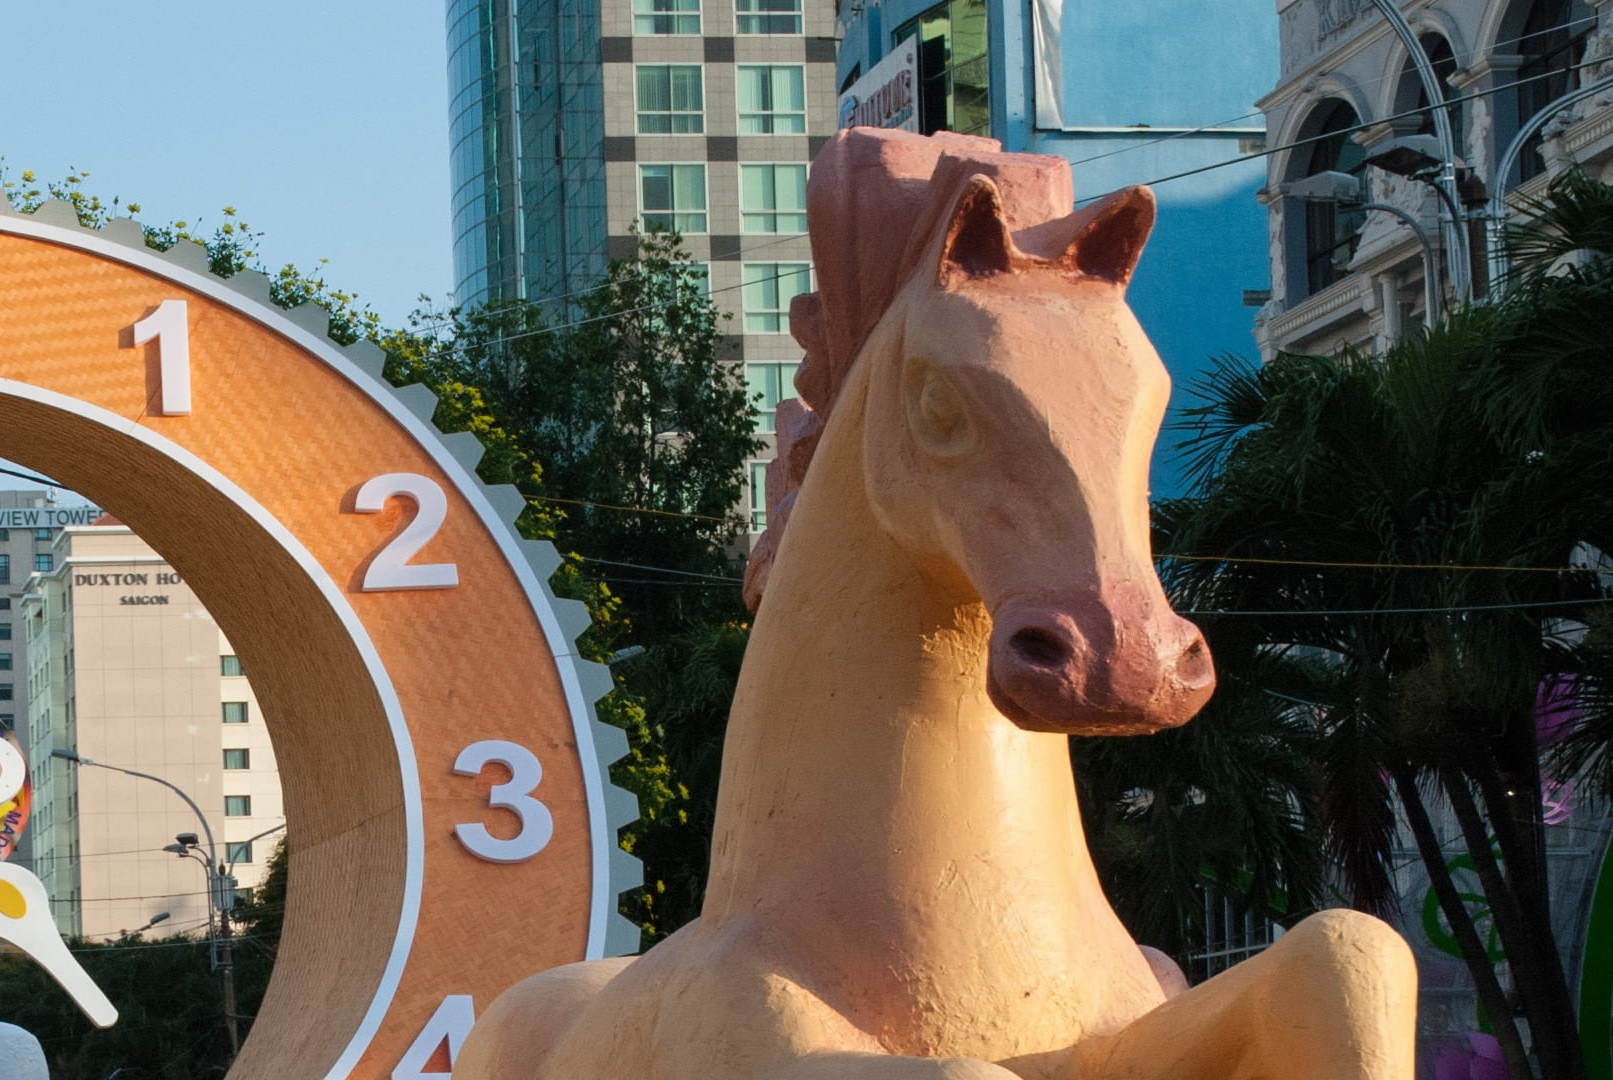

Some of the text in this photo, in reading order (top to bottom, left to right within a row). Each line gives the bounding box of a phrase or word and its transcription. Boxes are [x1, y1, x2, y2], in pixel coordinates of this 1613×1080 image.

[134, 299, 191, 413] 1
[45, 509, 105, 526] TOWE
[355, 472, 459, 590] 2
[75, 572, 183, 586] DUXTON HO
[119, 595, 170, 605] SAIGON
[454, 739, 555, 861] 3
